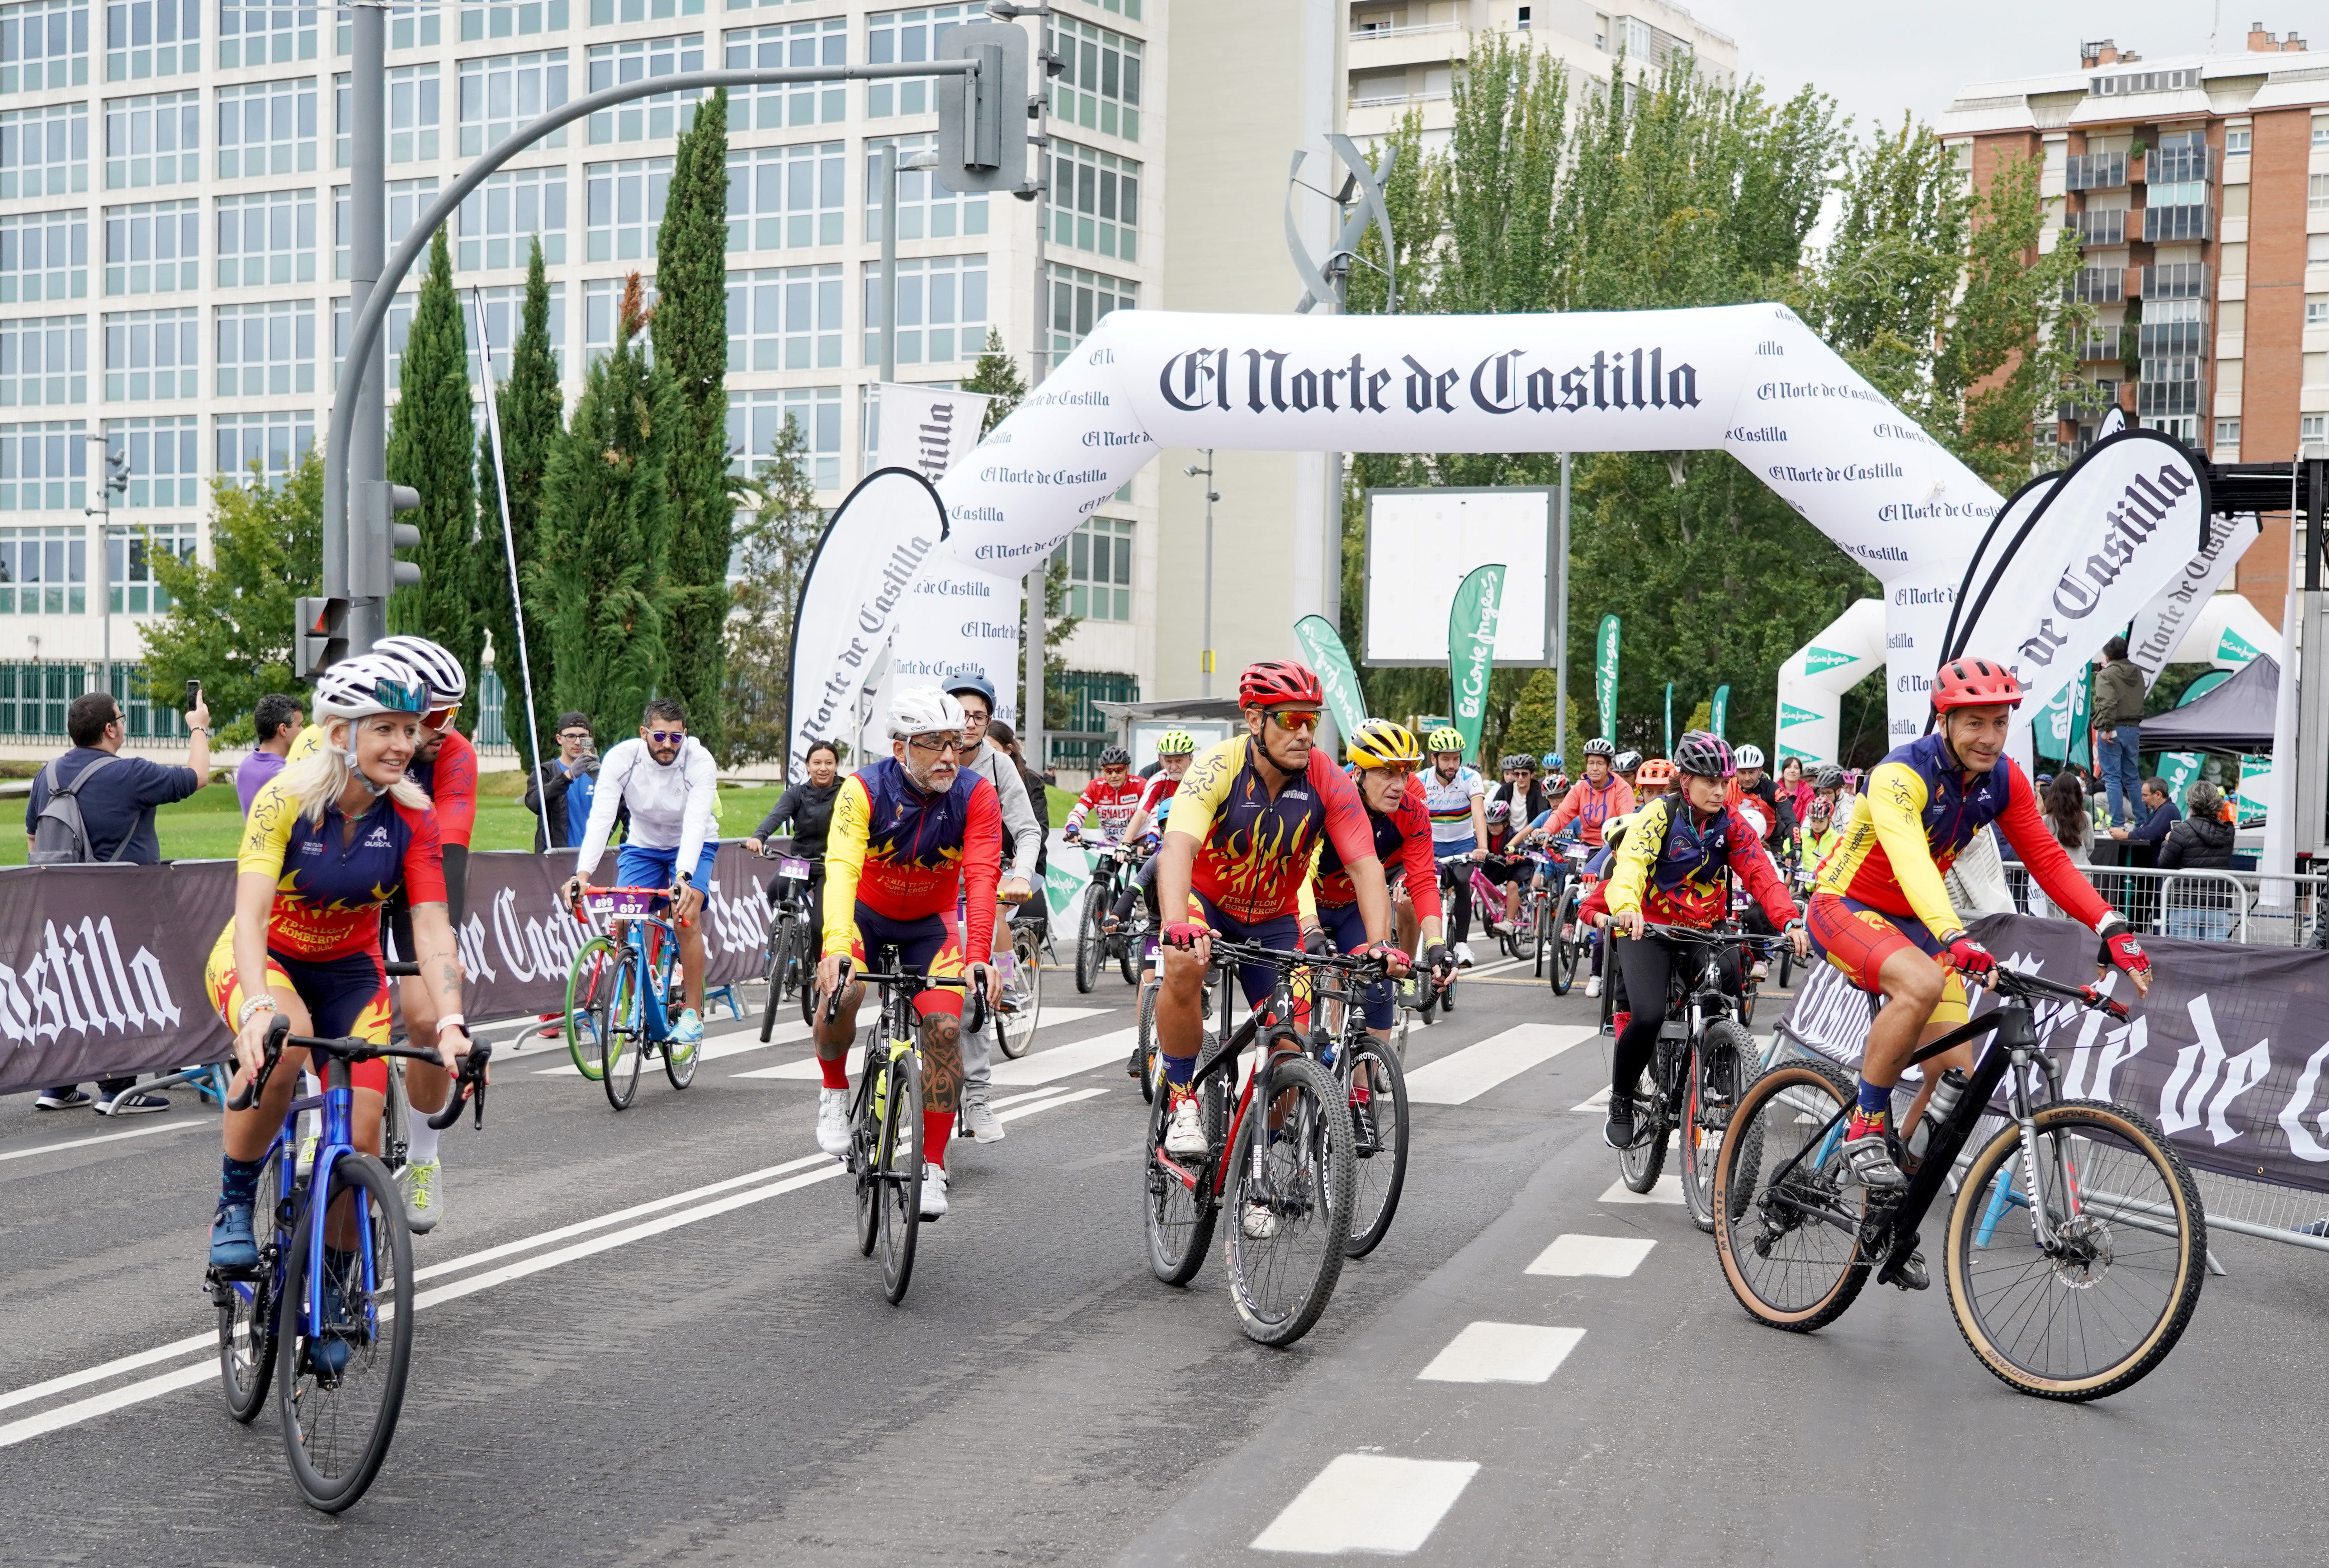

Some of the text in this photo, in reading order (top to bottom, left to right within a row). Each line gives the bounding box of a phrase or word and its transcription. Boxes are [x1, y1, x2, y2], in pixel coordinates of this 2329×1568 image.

[1160, 346, 1703, 414] El Norte de Castilla
[1045, 392, 1058, 405] de
[1059, 391, 1110, 406] Castilla
[1757, 382, 1887, 406] El Norte de Castilla
[1082, 432, 1100, 447] El
[1104, 432, 1139, 447] Norte
[1734, 427, 1787, 443] Castilla
[1874, 424, 1891, 438] El
[1895, 425, 1925, 445] Norte
[981, 467, 1107, 485] El Norte de Castilla
[1769, 462, 1903, 482] El Norte de Castilla
[952, 504, 1005, 522] Castilla
[1878, 504, 1898, 522] El
[1901, 502, 1942, 521] Norte
[1944, 503, 1959, 517] de
[975, 542, 1047, 560] El Norte de
[1857, 544, 1909, 562] Castilla
[2018, 464, 2194, 667] de Castilla
[922, 579, 990, 597] de Castilla
[1895, 589, 1909, 606] El
[1911, 589, 1944, 606] Norte
[961, 622, 978, 638] El
[982, 622, 1009, 639] Norte
[2136, 604, 2185, 663] Norte
[2168, 580, 2198, 605] de
[799, 672, 851, 744] Norte
[838, 636, 869, 668] de
[859, 535, 932, 633] Castilla
[919, 661, 931, 675] de
[1462, 646, 1488, 697] Corte
[1897, 676, 1909, 692] El
[1096, 806, 1135, 819] ESMALTIN
[785, 866, 803, 876] 651
[595, 897, 614, 908] 699
[619, 904, 643, 913] 697
[1224, 903, 1277, 914] BOMBEROS
[1228, 895, 1277, 907] TRIATLÓN
[2156, 993, 2271, 1147] de
[2049, 1110, 2100, 1121] HORNET
[1716, 1190, 1729, 1251] MAXXIS
[1985, 1349, 2043, 1384] CHAOYANG
